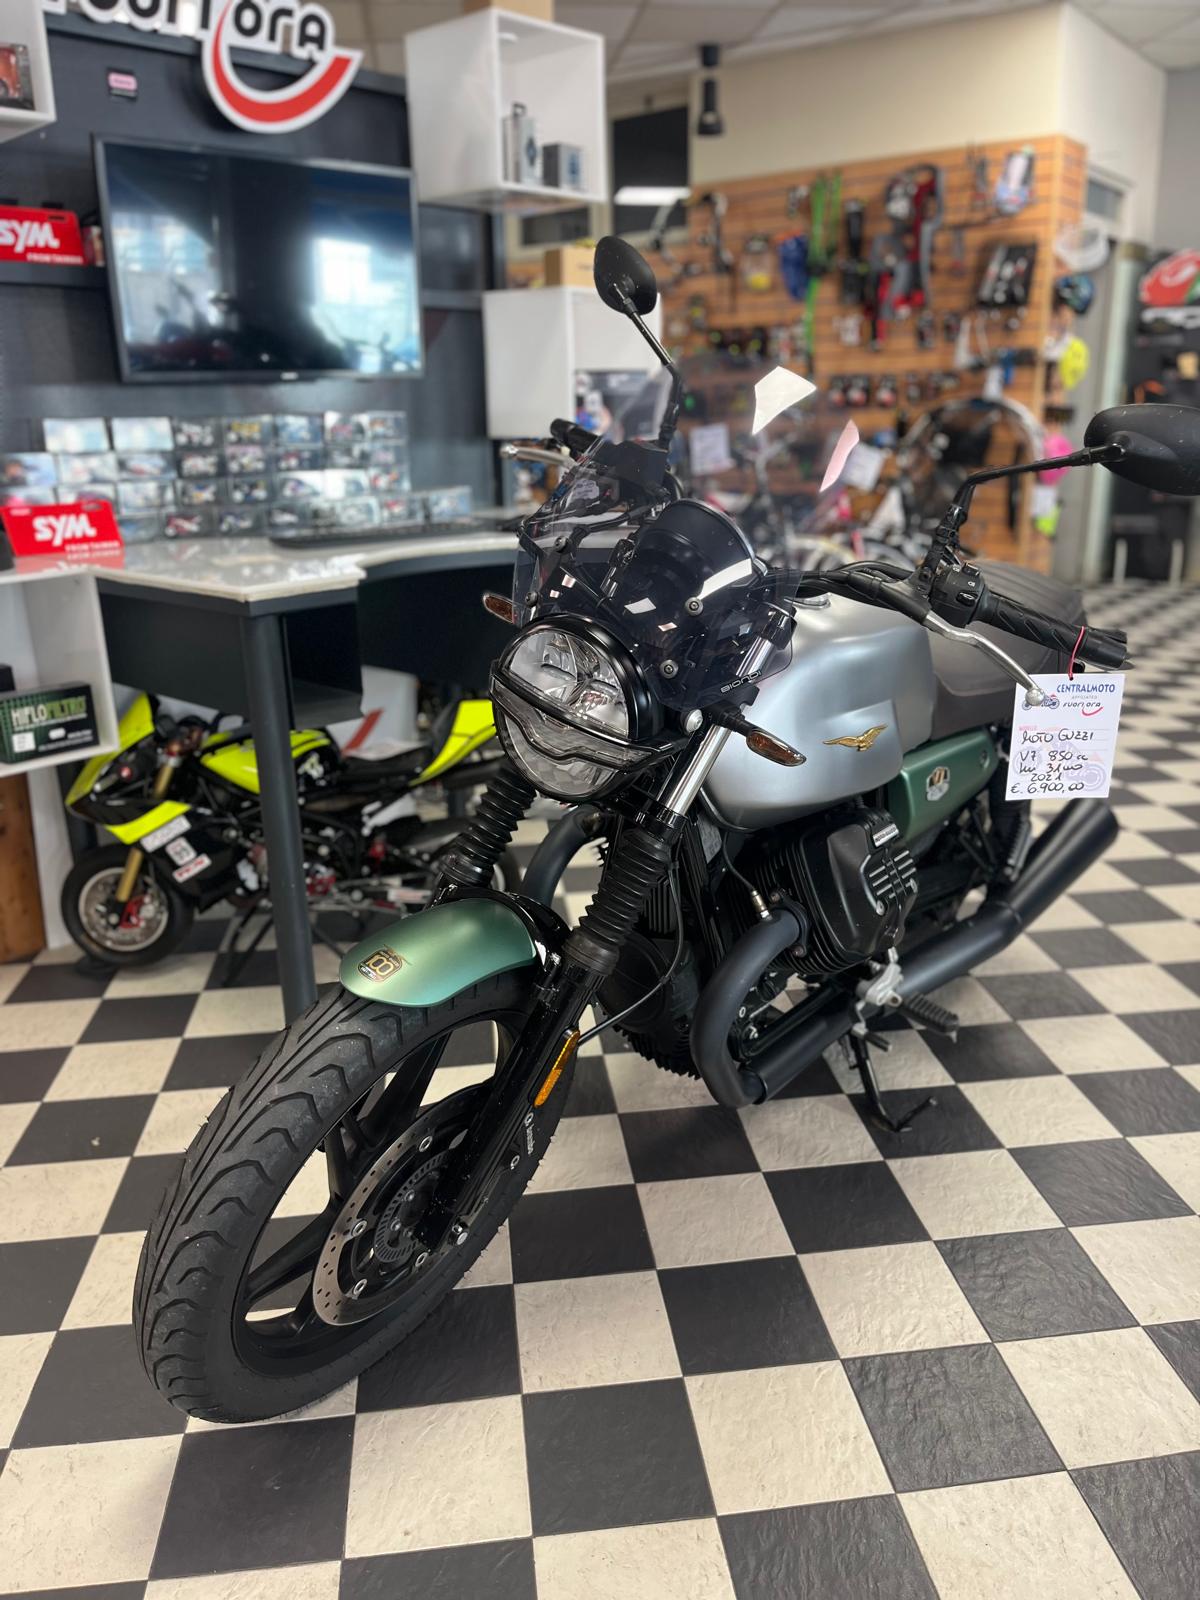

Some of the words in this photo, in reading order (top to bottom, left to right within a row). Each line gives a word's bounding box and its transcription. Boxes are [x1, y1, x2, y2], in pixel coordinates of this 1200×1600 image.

[33, 513, 97, 547] SYM
[1057, 683, 1116, 693] CENTRALMOTO
[1058, 728, 1094, 741] GUZZI
[1020, 751, 1036, 761] V7
[1048, 751, 1073, 761] 850
[1031, 772, 1062, 782] 2021
